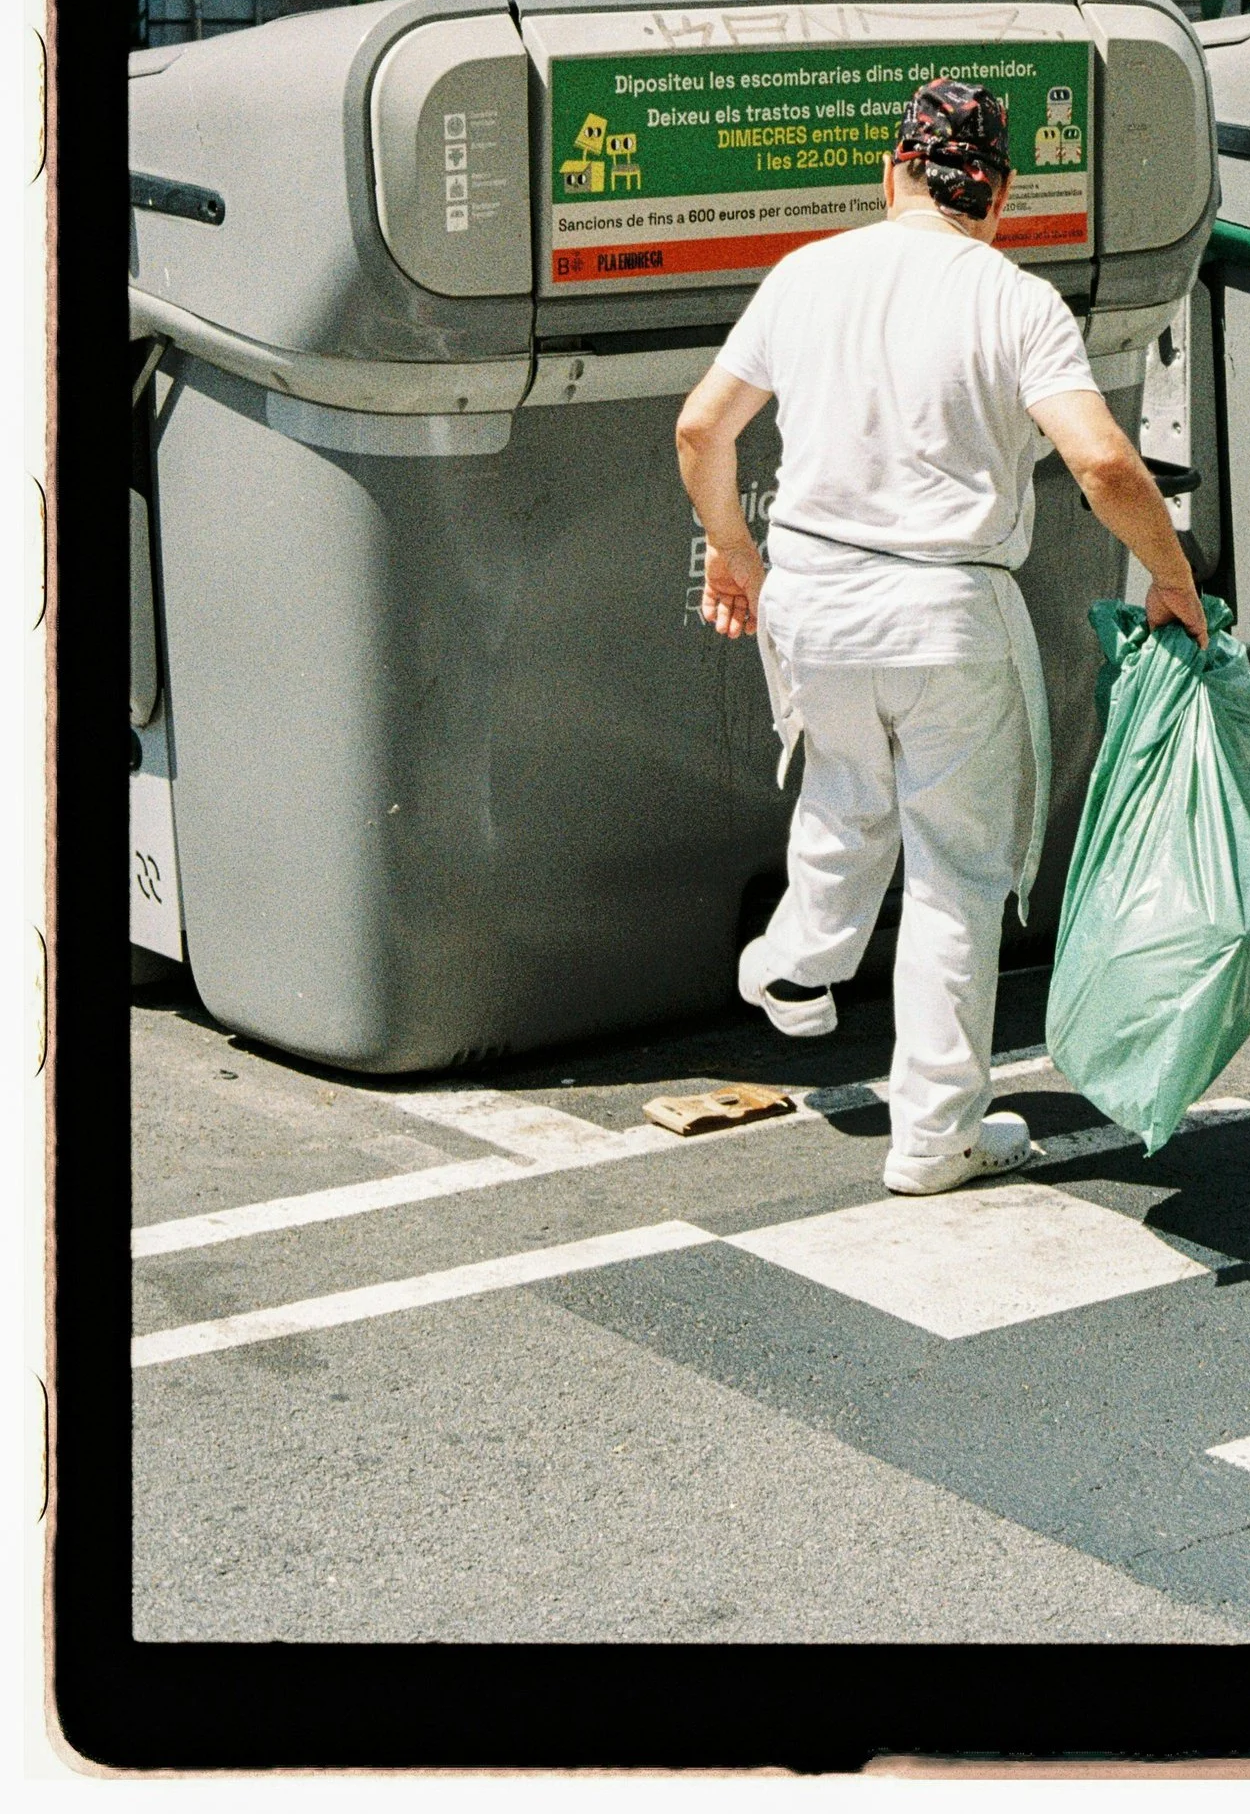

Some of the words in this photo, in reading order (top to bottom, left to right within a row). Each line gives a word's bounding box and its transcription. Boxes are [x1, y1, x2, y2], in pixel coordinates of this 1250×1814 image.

[615, 72, 704, 97] Dipositeu
[709, 71, 736, 89] les
[740, 66, 861, 88] escombraries
[866, 65, 903, 83] dins
[908, 63, 935, 82] del
[940, 60, 1037, 79] contenidor.
[647, 108, 710, 128] Deixeu
[715, 105, 741, 124] els
[746, 103, 810, 122] trastos
[815, 99, 855, 118] vells
[718, 125, 807, 149] DIMECRES
[812, 125, 862, 143] entre
[865, 123, 889, 141] les
[757, 153, 762, 171] i
[767, 151, 791, 170] les
[796, 149, 848, 169] 22.00
[558, 217, 623, 232] Sancions
[626, 214, 644, 228] de
[648, 212, 673, 226] fins
[676, 214, 685, 224] a
[688, 209, 716, 223] 600
[719, 208, 756, 222] euros
[759, 206, 780, 222] per
[784, 200, 847, 217] combatre
[849, 198, 887, 213] l'inciv
